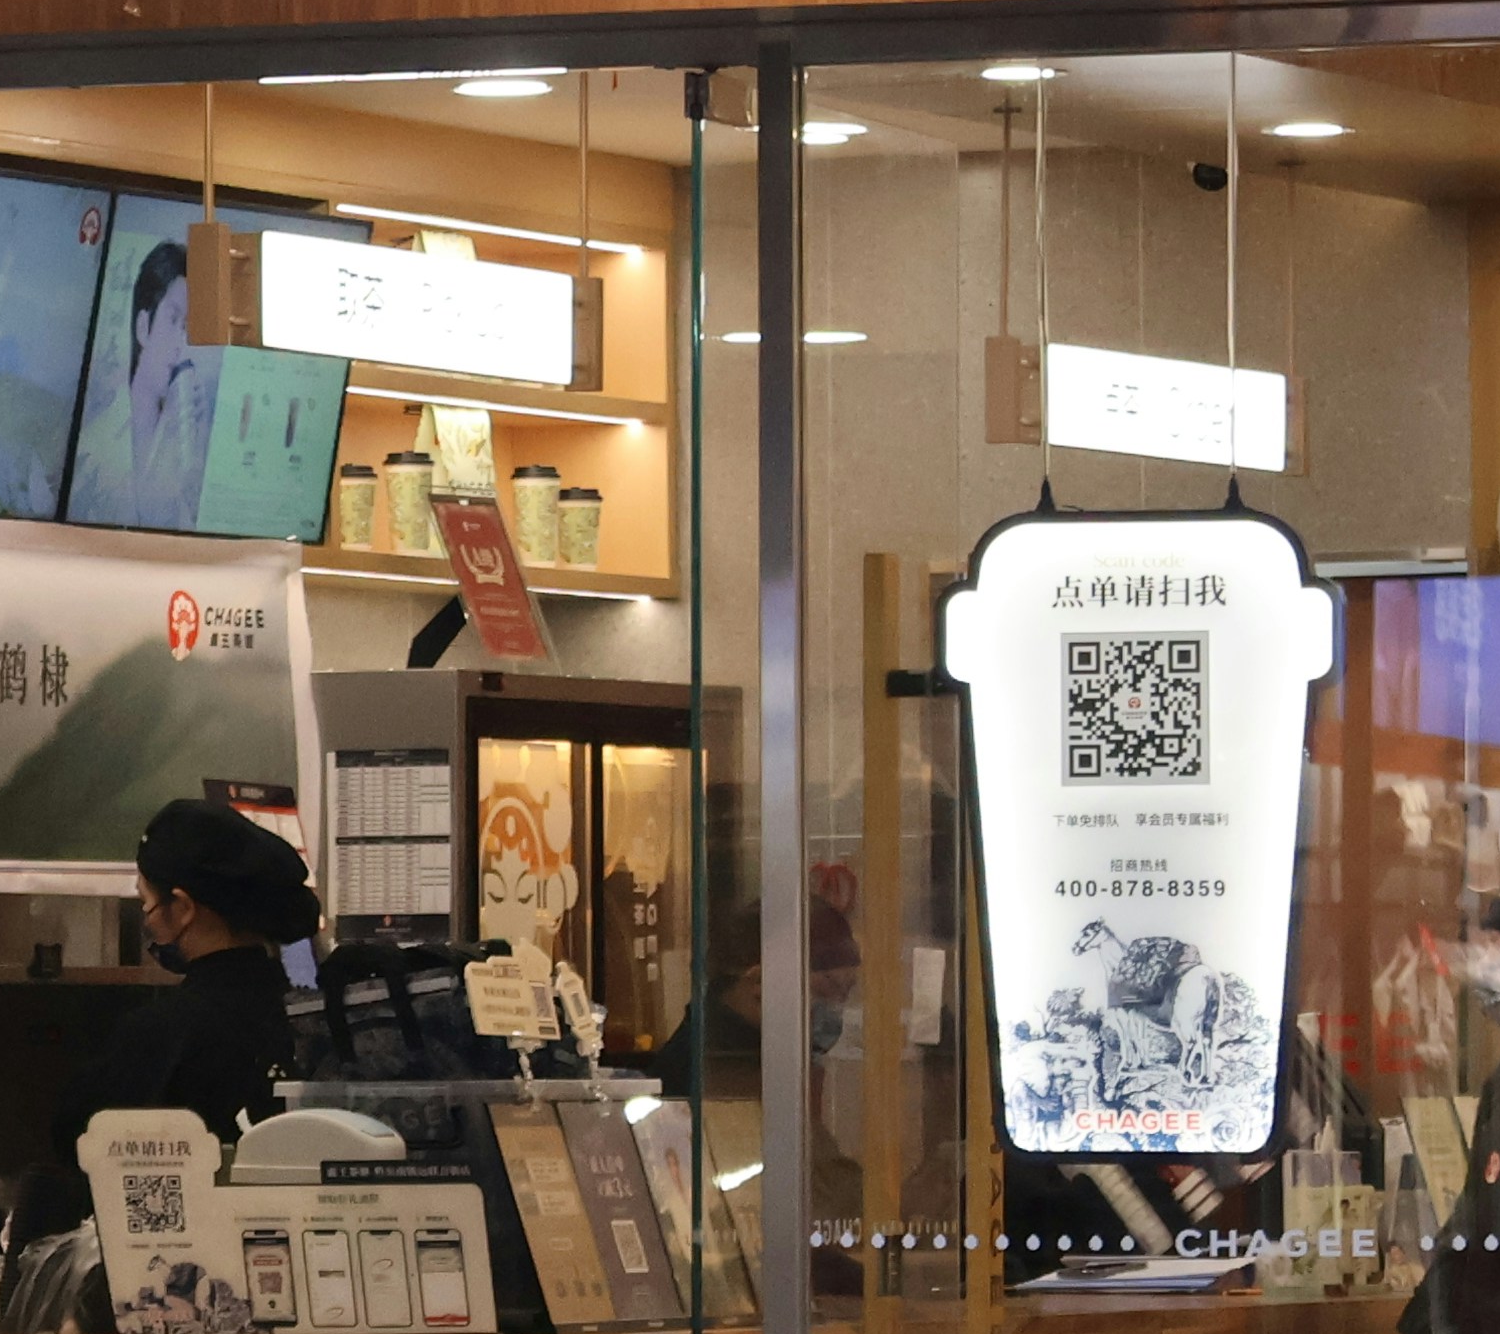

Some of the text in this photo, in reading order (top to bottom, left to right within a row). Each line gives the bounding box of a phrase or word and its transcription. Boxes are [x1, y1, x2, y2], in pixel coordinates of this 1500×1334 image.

[1052, 574, 1227, 609] 点单请扫我
[205, 606, 265, 630] CHAGEE
[1055, 879, 1227, 897] 400-878-8359
[1075, 1111, 1201, 1131] CHAGEE
[1175, 1228, 1377, 1258] CHAGEE
